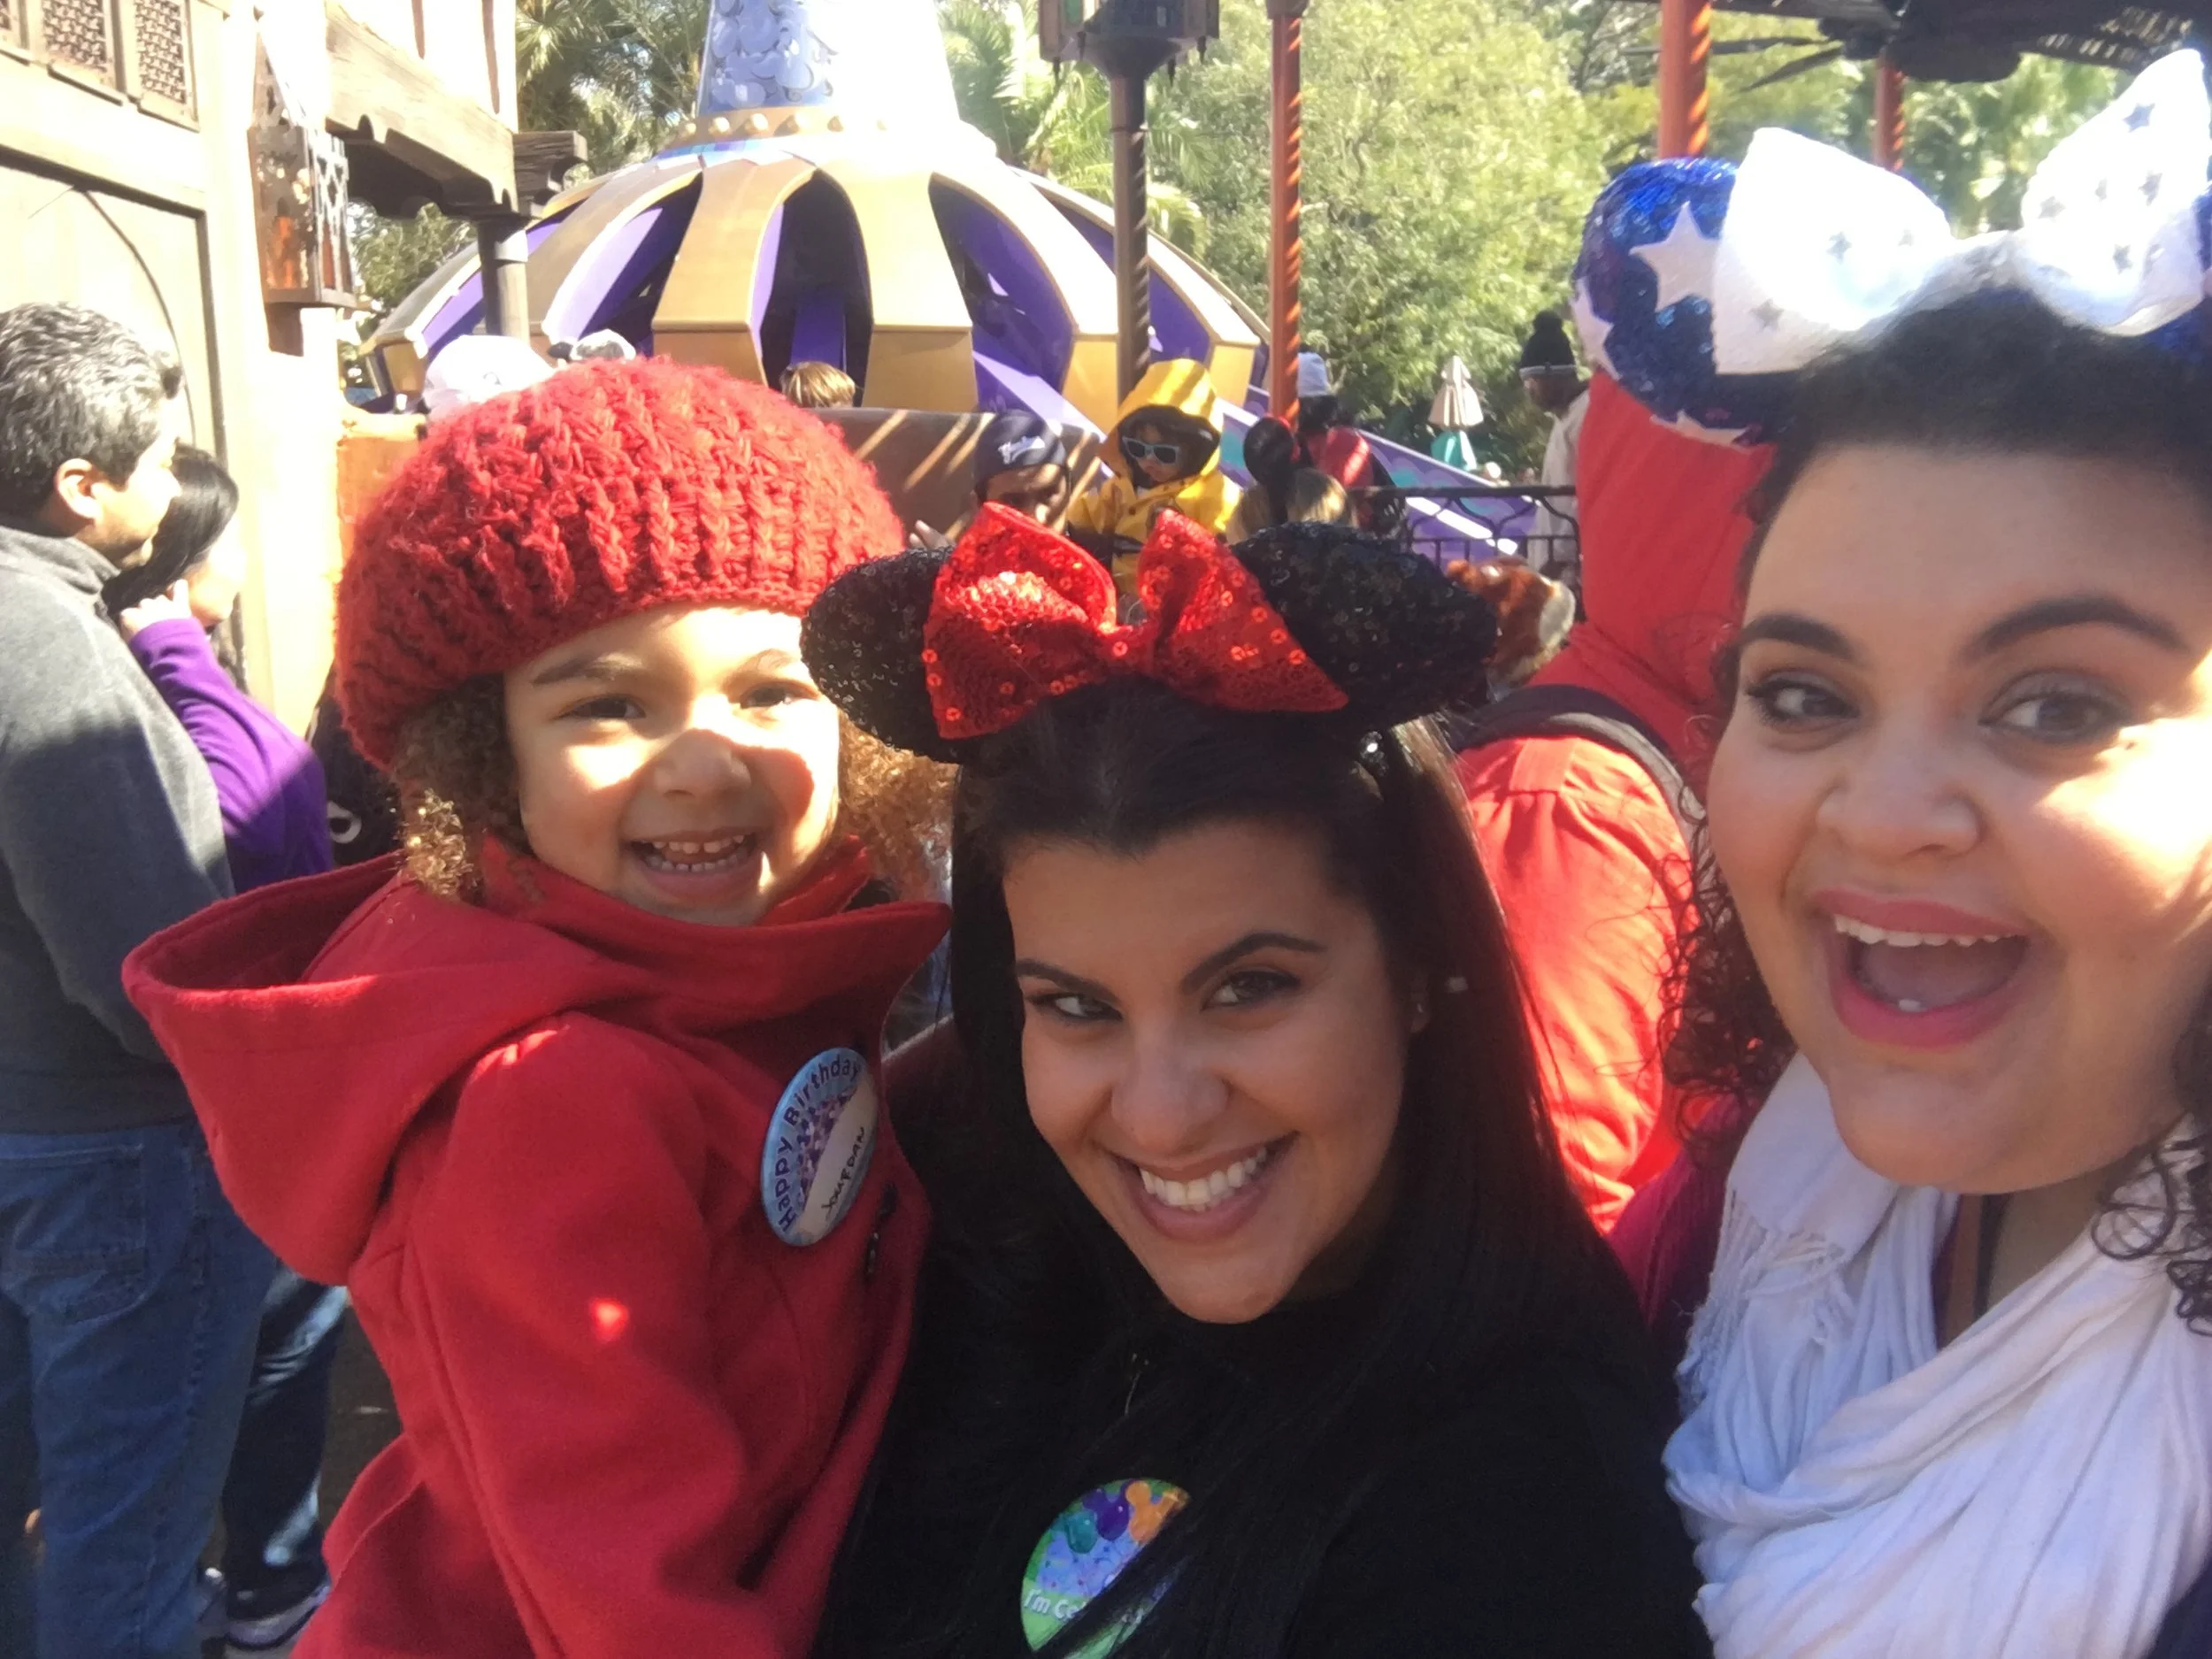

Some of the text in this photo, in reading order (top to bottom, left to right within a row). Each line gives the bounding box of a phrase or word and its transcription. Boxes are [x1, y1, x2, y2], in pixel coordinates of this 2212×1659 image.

[774, 1054, 861, 1233] Happy Birthday
[1024, 1588, 1051, 1614] I'm
